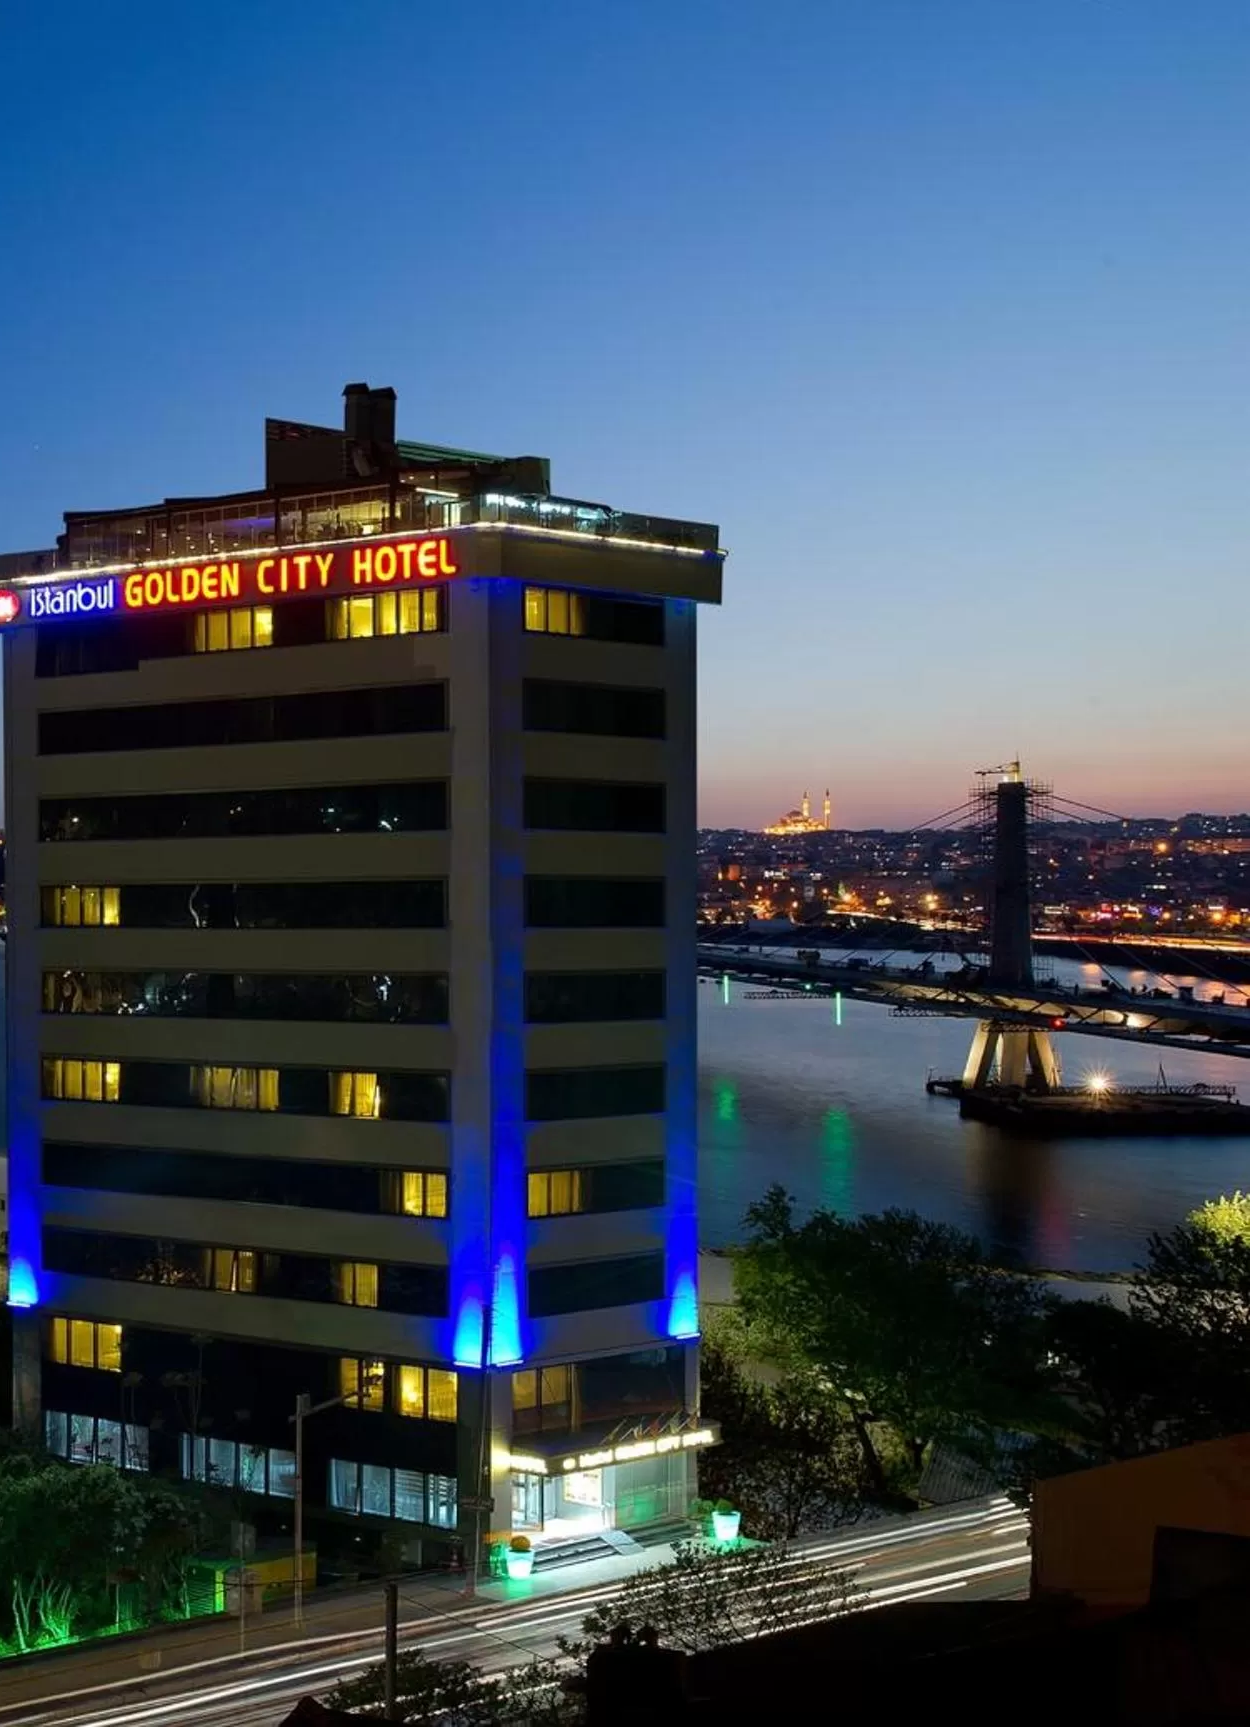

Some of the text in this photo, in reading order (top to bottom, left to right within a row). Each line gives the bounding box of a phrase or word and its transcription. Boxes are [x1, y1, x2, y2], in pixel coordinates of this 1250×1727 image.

[124, 558, 240, 608] GOLDEN
[256, 552, 335, 594] CITY
[350, 538, 457, 585] HOTEL
